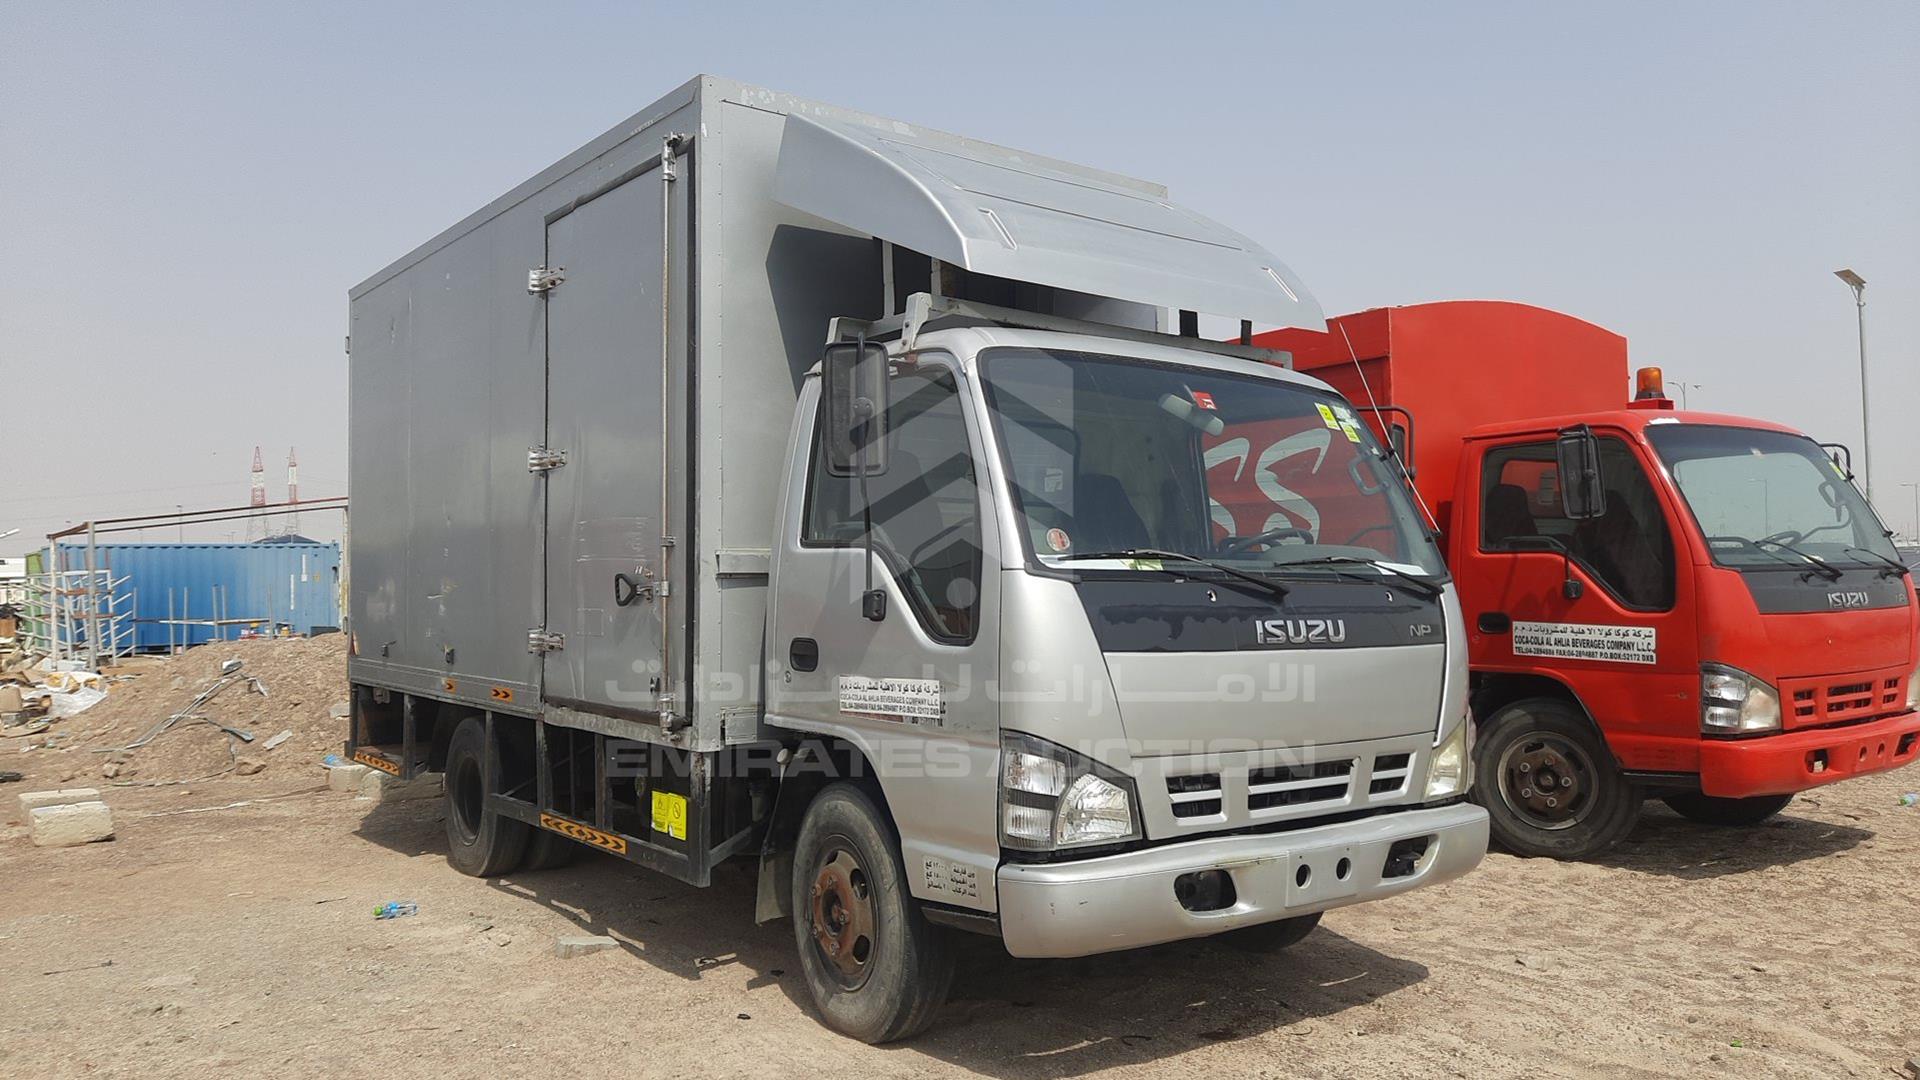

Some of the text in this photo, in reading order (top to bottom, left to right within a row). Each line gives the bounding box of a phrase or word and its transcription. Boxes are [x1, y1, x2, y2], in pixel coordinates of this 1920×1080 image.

[1827, 591, 1869, 609] ISUZU
[1255, 619, 1346, 644] ISUZU
[1533, 624, 1568, 636] للمشروبات
[1599, 627, 1612, 639] كولا
[1614, 627, 1630, 639] كوكا
[1632, 629, 1653, 640] شركة
[1514, 635, 1545, 646] COCA-COLA
[1545, 637, 1553, 647] AL
[1554, 638, 1570, 649] AHLIA
[1571, 639, 1606, 650] BEVERAGES
[1606, 640, 1636, 651] COMPANY
[898, 683, 909, 695] كولا
[910, 683, 923, 696] كوكا
[924, 683, 939, 696] شركة
[880, 696, 905, 704] BEVERAGES
[905, 697, 927, 705] COMPANY
